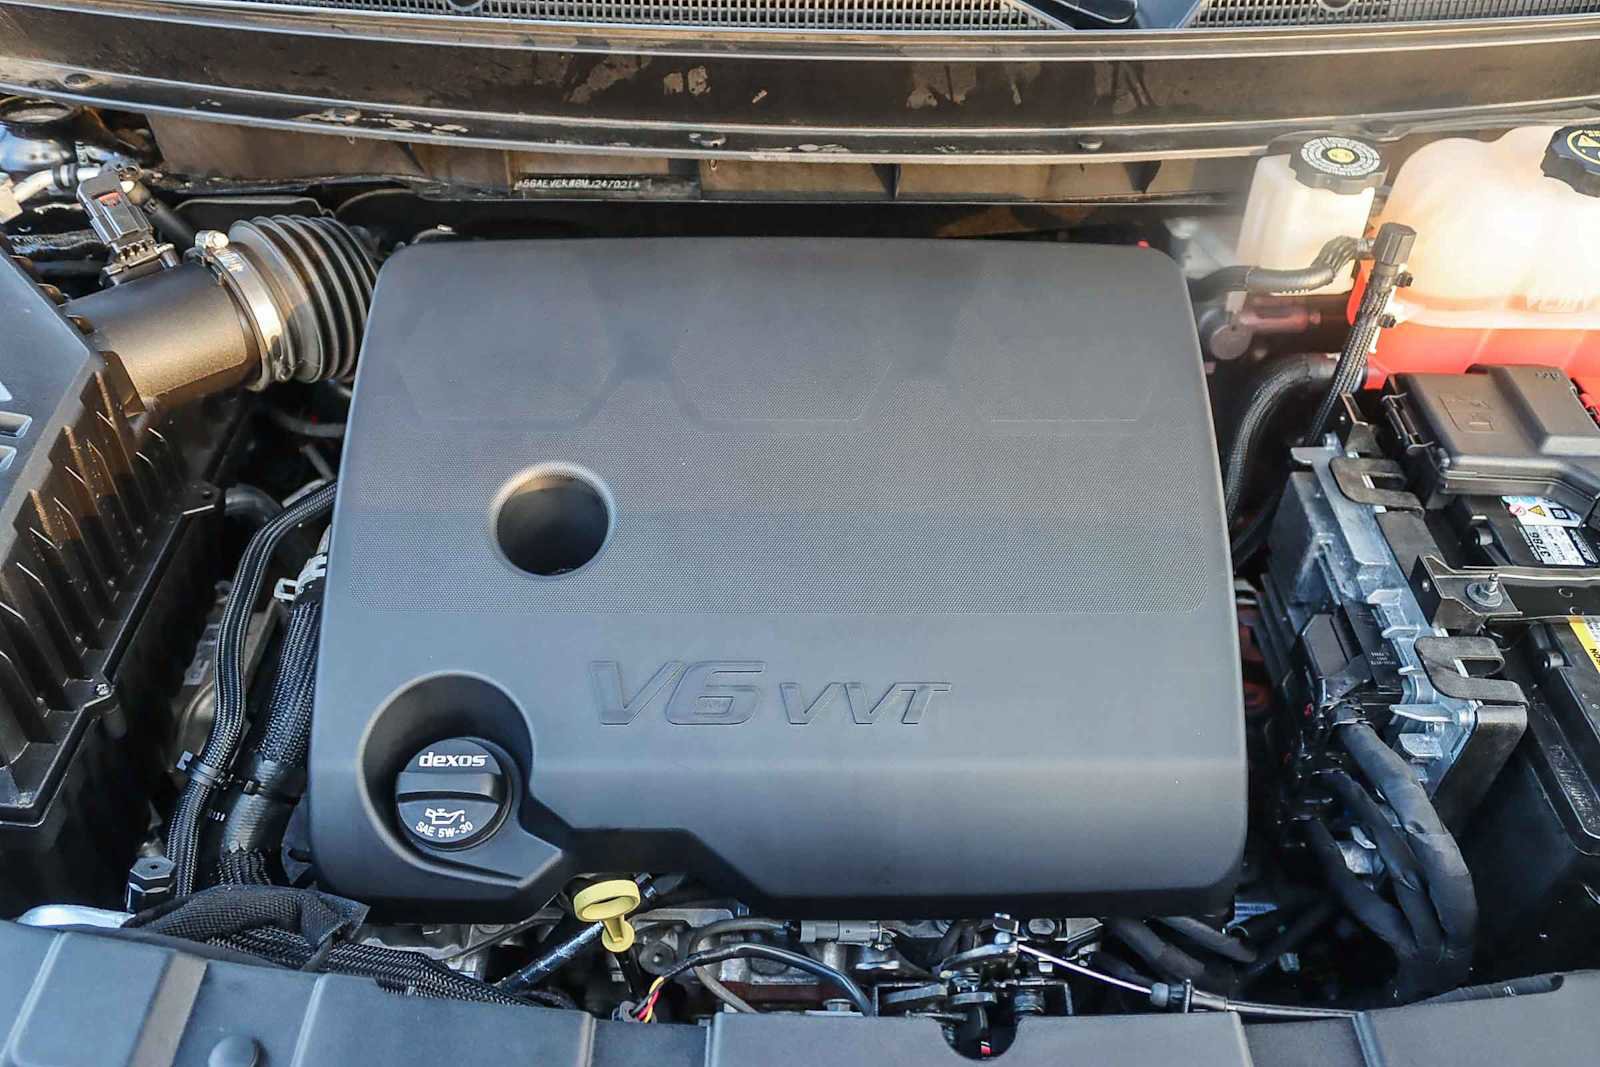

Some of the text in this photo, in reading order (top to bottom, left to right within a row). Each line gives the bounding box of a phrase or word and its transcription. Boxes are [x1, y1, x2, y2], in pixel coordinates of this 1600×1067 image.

[591, 660, 951, 725] V6 VVT
[418, 751, 489, 768] dexos
[415, 820, 474, 838] SAE 5W-30
